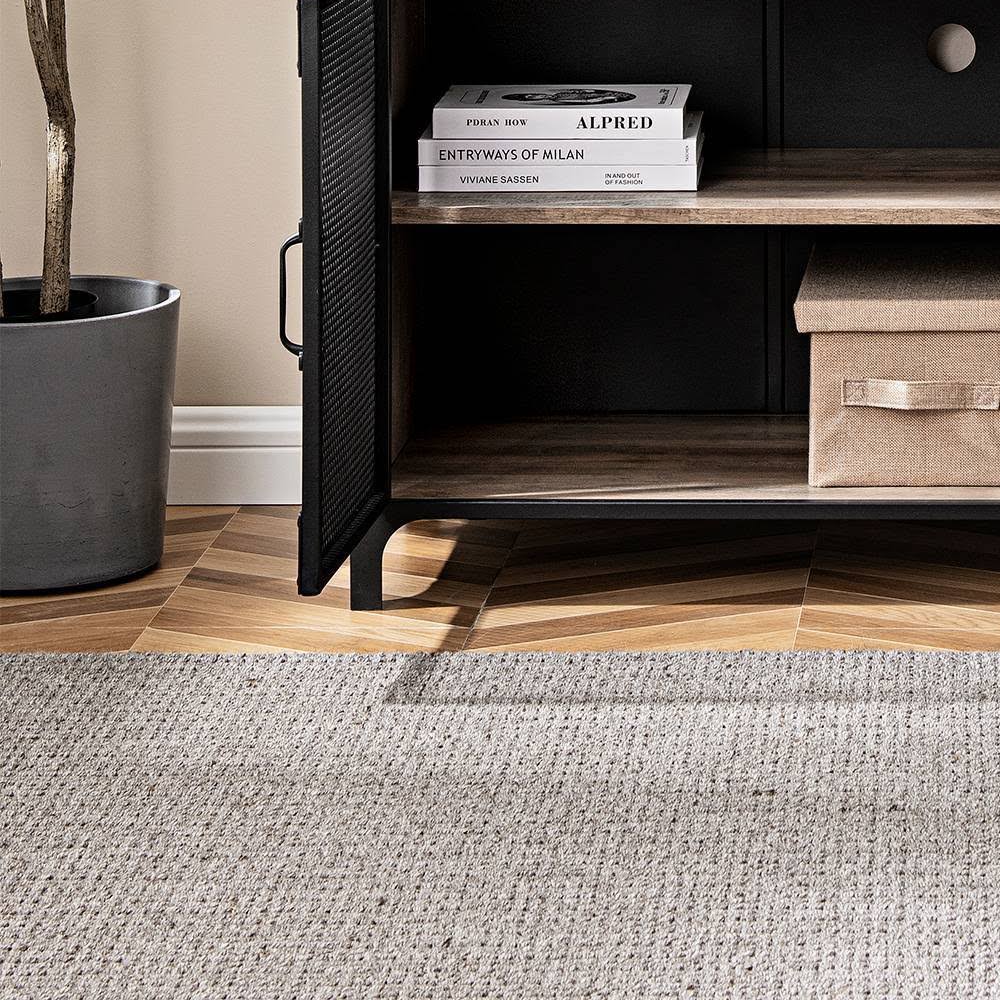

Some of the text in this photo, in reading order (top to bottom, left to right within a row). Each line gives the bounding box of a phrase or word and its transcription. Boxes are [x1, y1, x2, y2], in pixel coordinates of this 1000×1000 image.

[576, 116, 653, 130] ALPRED
[439, 149, 584, 161] ENTRYWAYS OF MILAN
[460, 176, 539, 184] VIVIANE SASSEN
